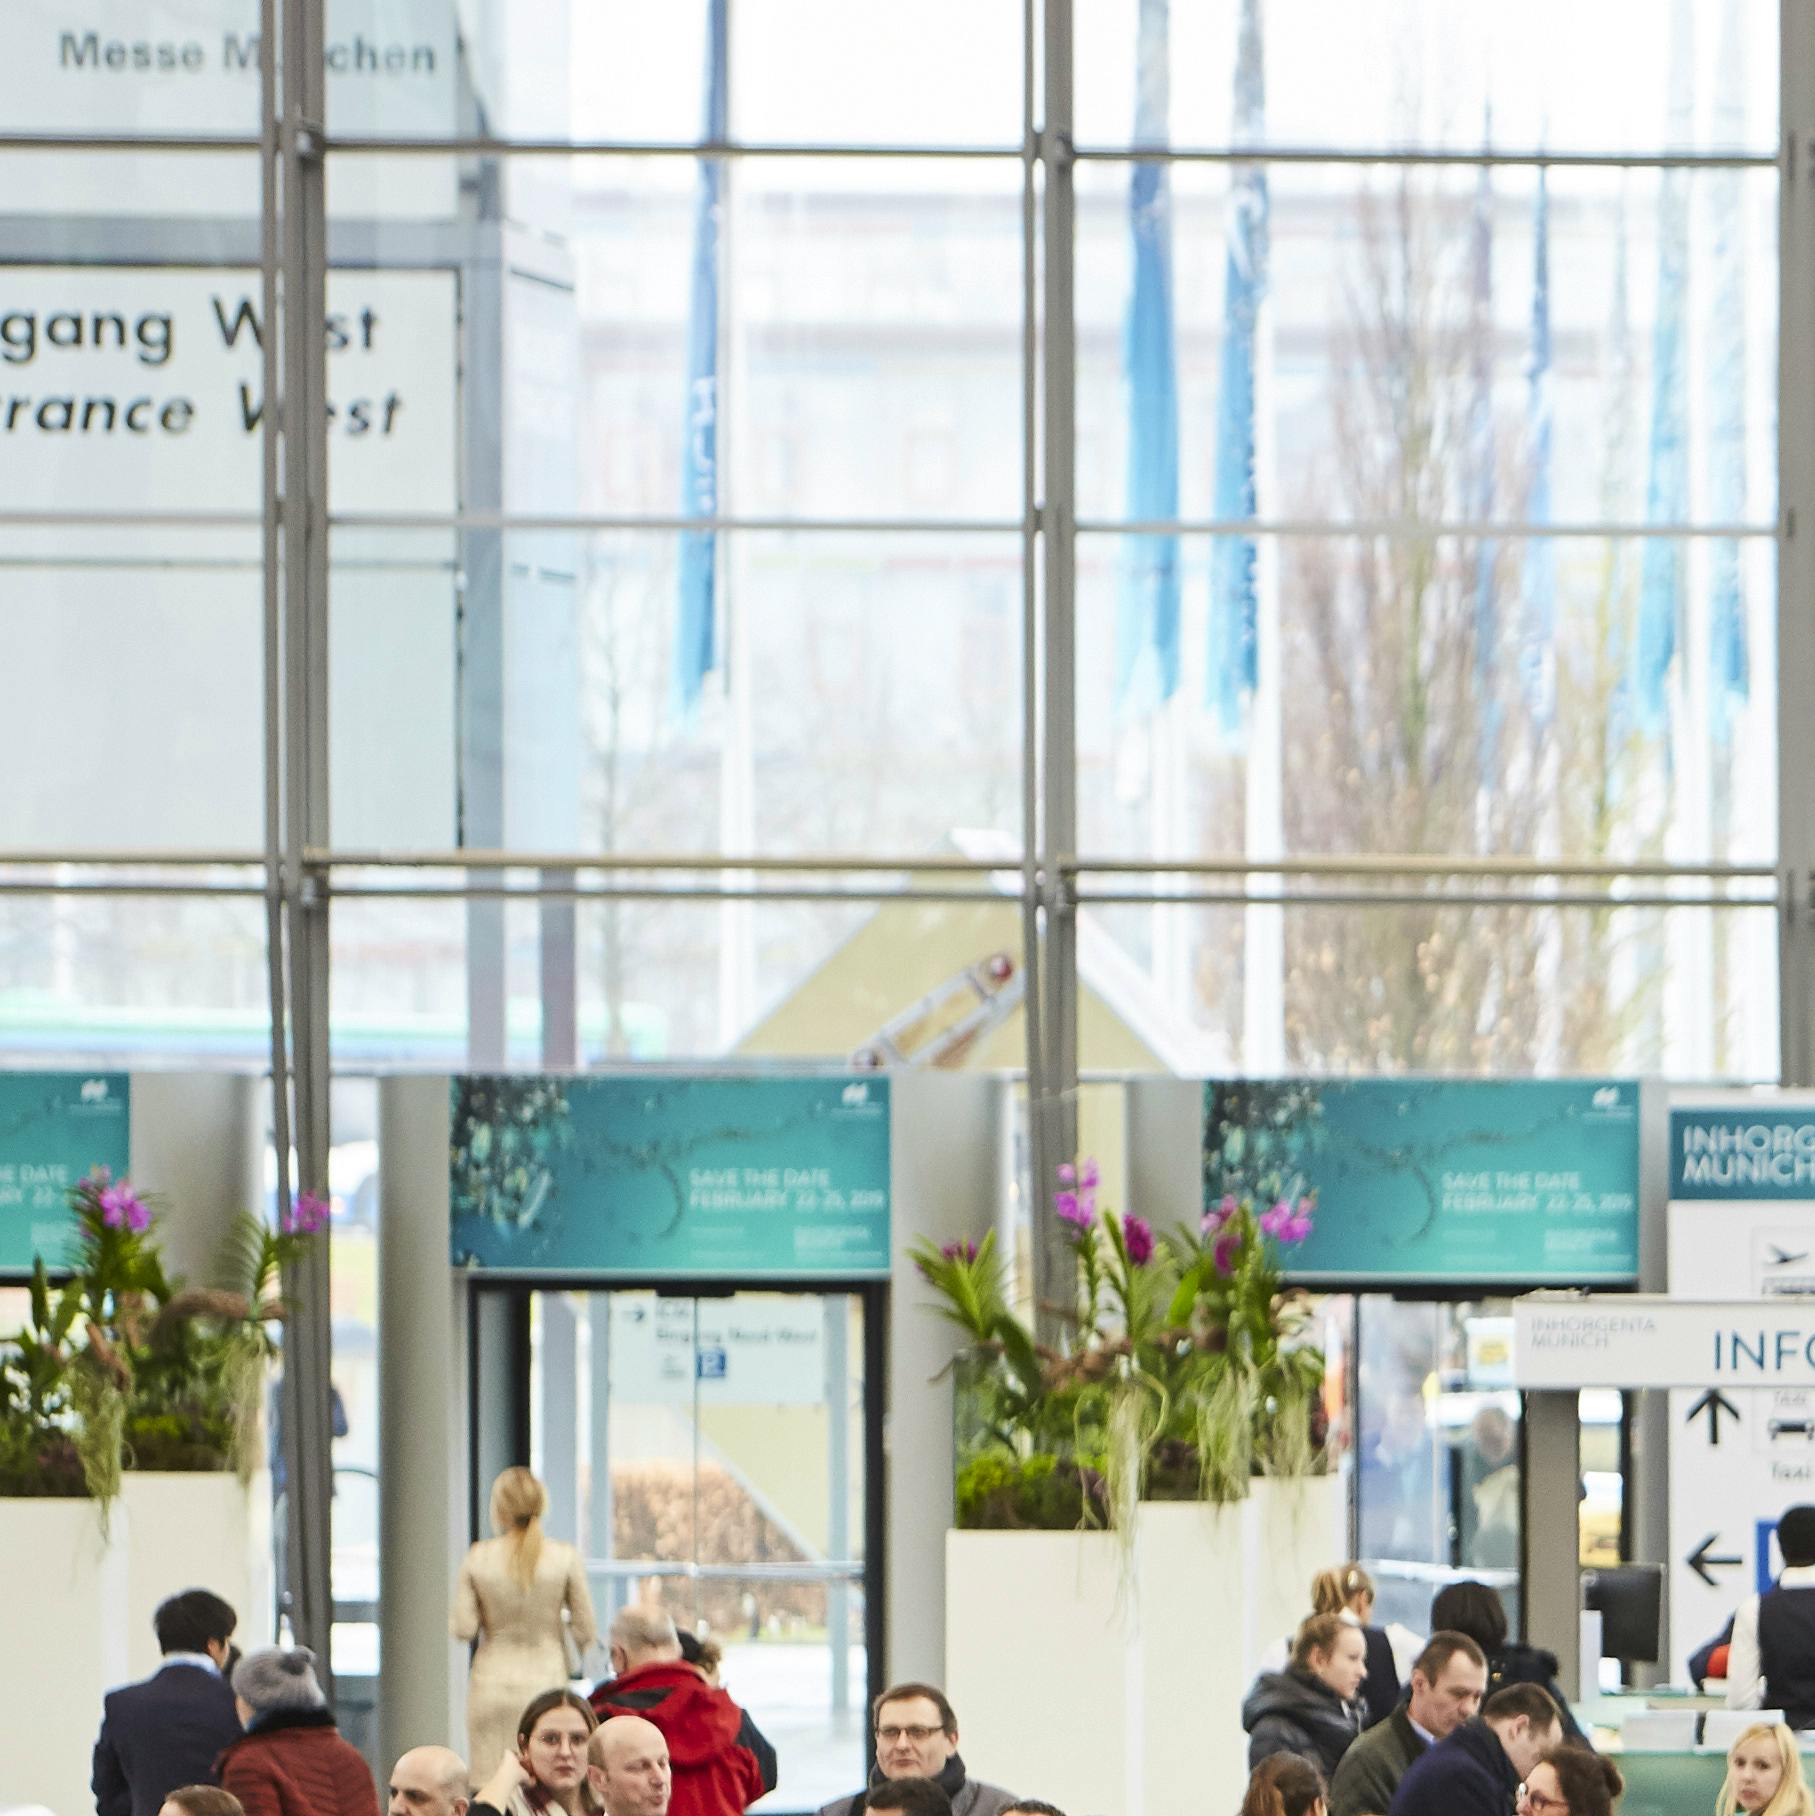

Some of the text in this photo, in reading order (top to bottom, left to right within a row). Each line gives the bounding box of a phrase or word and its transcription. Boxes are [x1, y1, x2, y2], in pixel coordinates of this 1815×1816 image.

[59, 31, 437, 72] Messe Mchen
[210, 294, 379, 350] Wst
[0, 382, 404, 434] rance Wst
[1530, 1315, 1657, 1333] INHORGENTA
[1530, 1333, 1609, 1349] MUNICH
